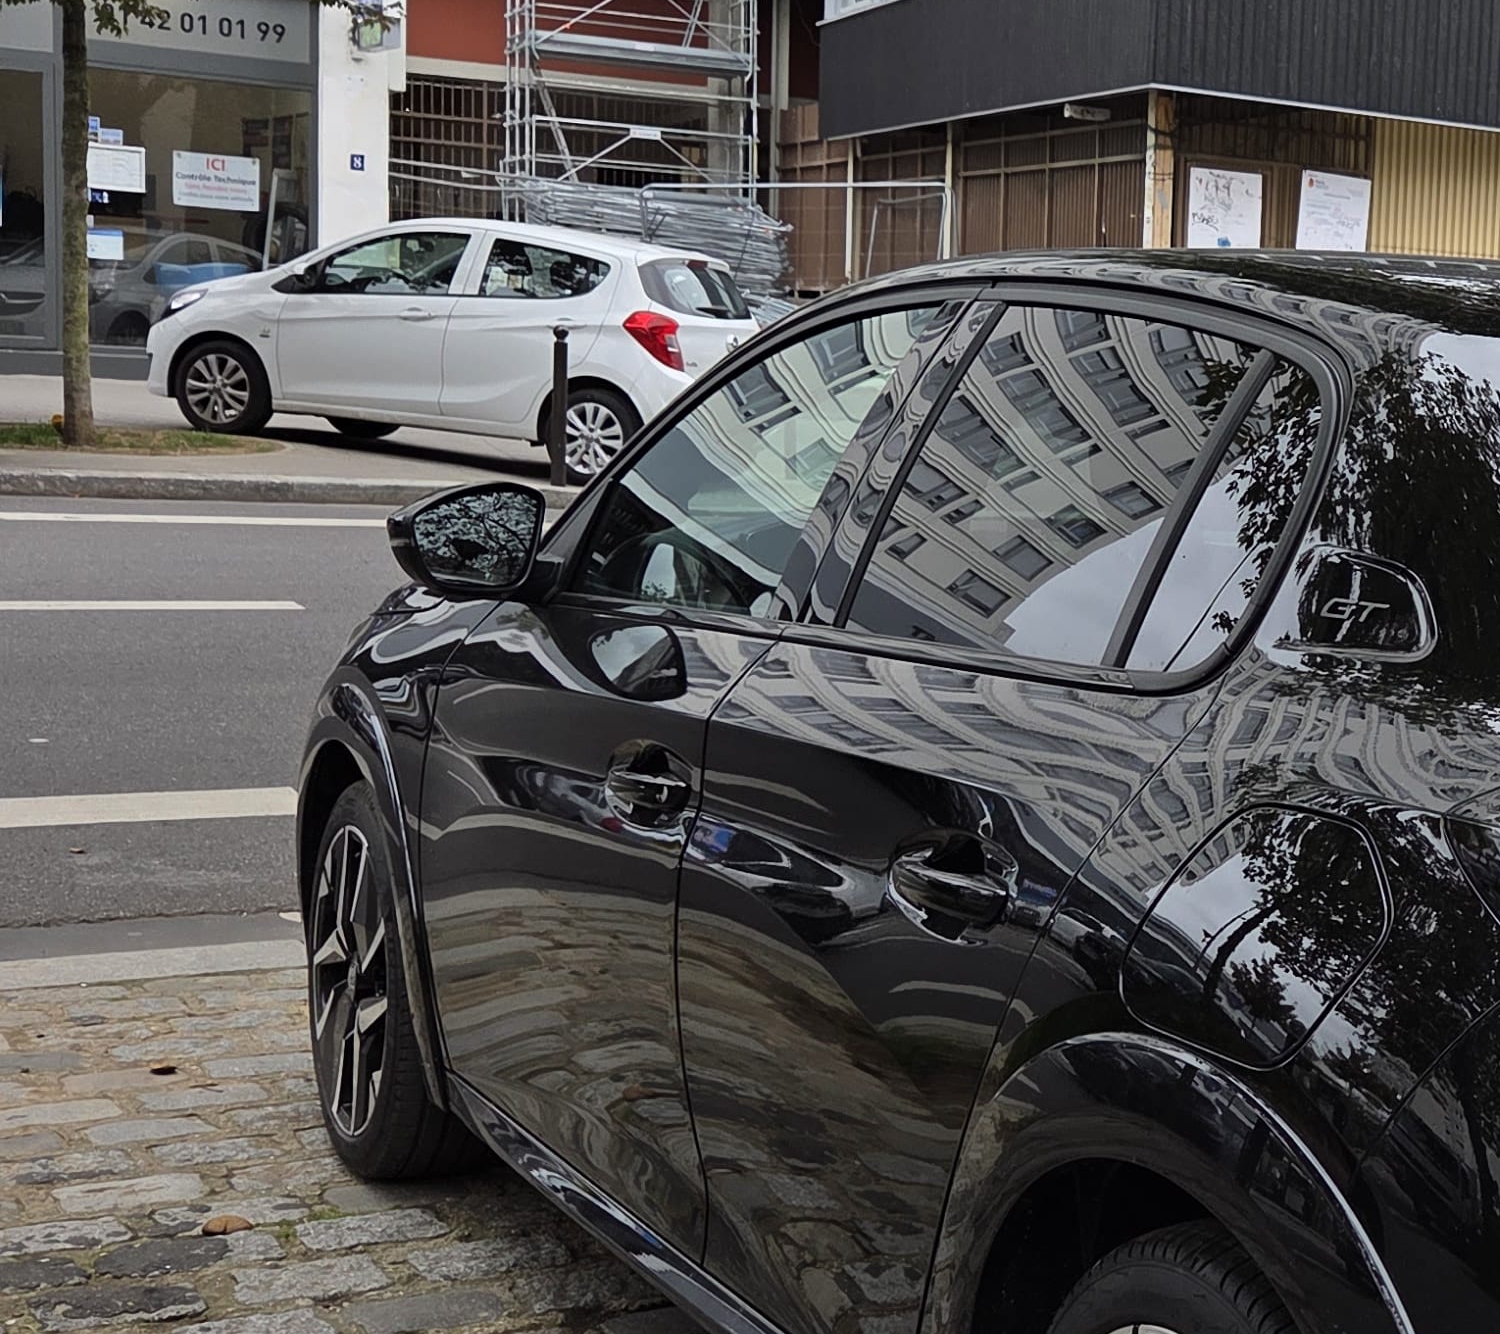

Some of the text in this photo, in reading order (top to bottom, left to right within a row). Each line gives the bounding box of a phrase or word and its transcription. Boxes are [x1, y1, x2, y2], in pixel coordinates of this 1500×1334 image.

[180, 12, 208, 36] 01
[218, 17, 246, 40] 01
[256, 21, 286, 44] 99
[206, 157, 226, 172] ICI
[353, 156, 363, 168] 8
[1319, 596, 1391, 623] GT
